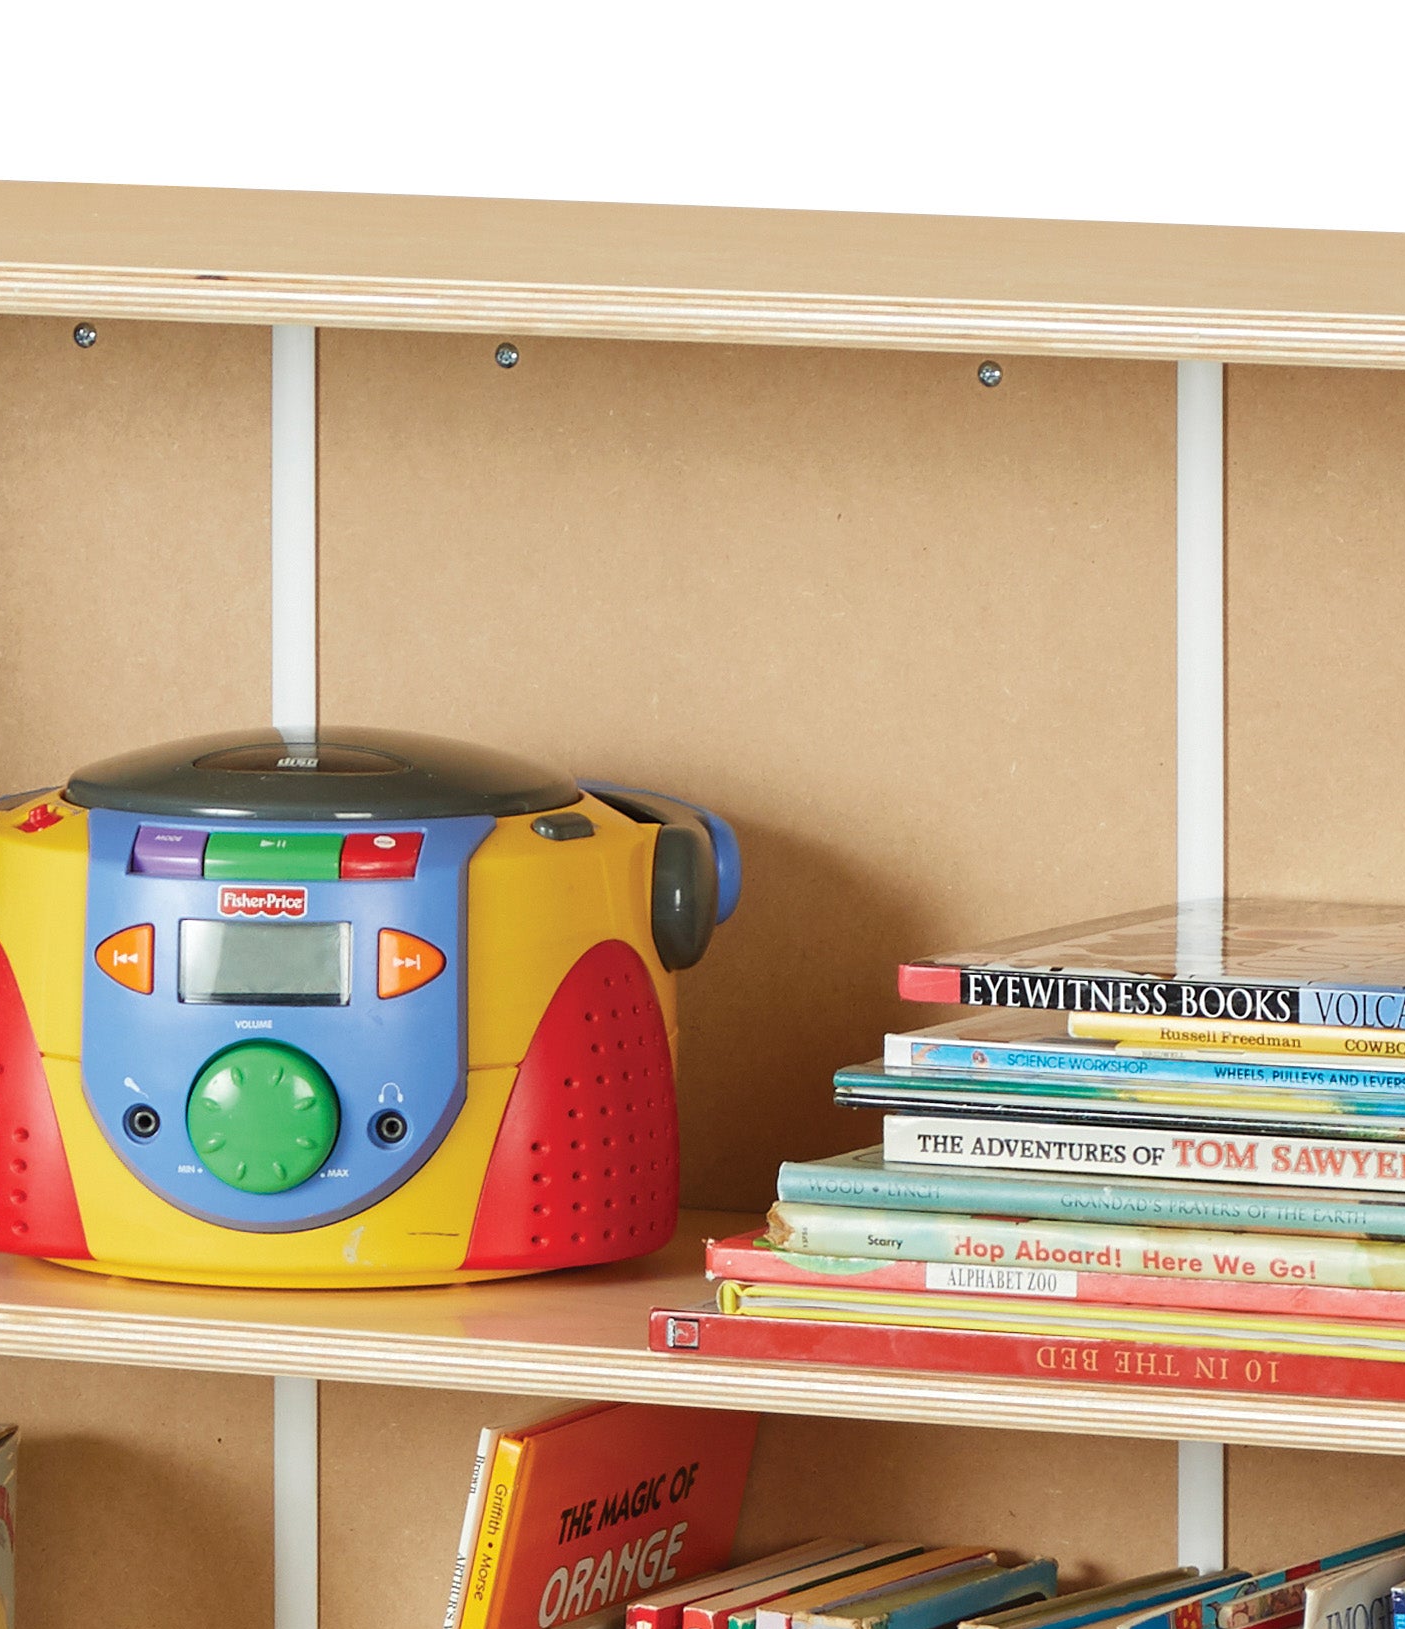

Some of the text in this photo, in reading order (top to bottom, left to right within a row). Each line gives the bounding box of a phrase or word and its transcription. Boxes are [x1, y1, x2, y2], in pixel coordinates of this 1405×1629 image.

[968, 973, 1168, 1017] EYEWITNESS
[1180, 986, 1292, 1022] BOOKS
[235, 1020, 273, 1029] VOLUME
[1159, 1027, 1218, 1045] Russell
[1221, 1031, 1302, 1049] Freedman
[1007, 1052, 1065, 1071] SCIENCE
[917, 1134, 963, 1154] THE
[969, 1136, 1126, 1164] ADVENTURES
[327, 1169, 349, 1178] MAX
[807, 1177, 865, 1196] WOOD
[866, 1234, 903, 1250] Scarry
[954, 1236, 1004, 1262] Hop
[1016, 1239, 1122, 1266] Aboard!
[1142, 1250, 1203, 1273] Here
[1269, 1259, 1317, 1279] Go!
[947, 1267, 1022, 1291] ALPHABET
[1037, 1347, 1099, 1372] BED
[558, 1463, 699, 1546] THE MAGIC OF
[537, 1521, 688, 1629] ORANGE
